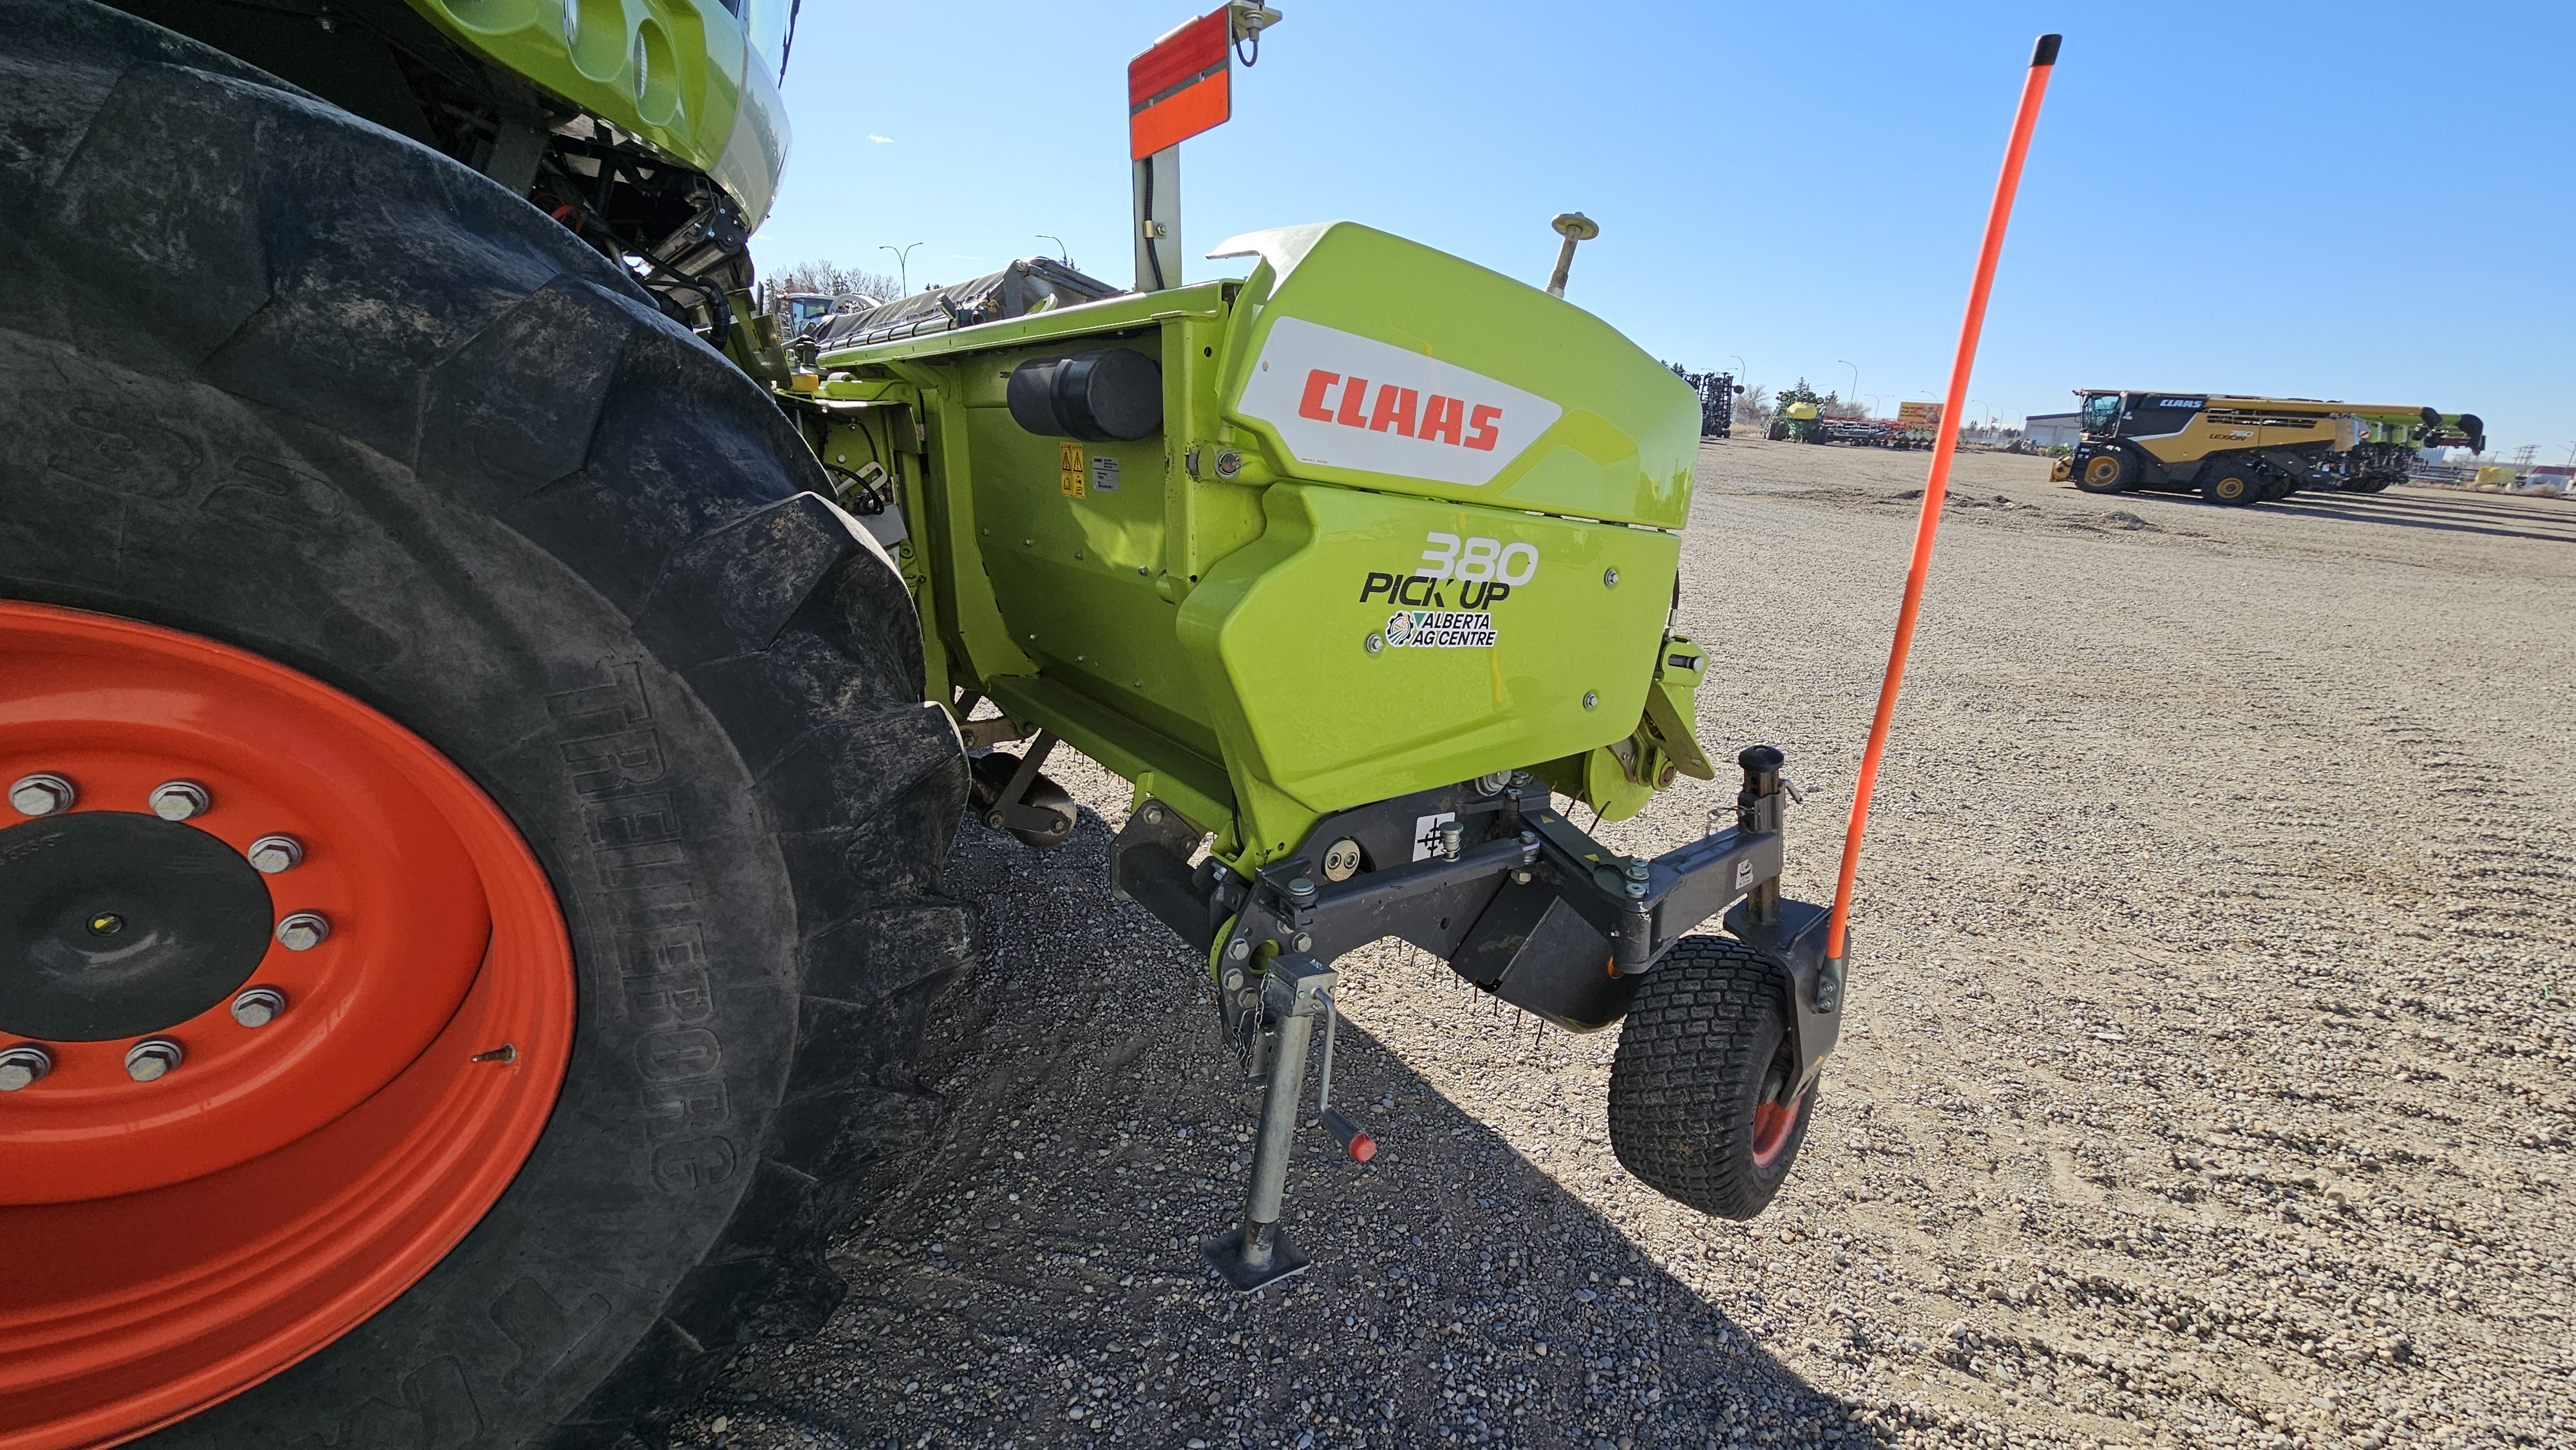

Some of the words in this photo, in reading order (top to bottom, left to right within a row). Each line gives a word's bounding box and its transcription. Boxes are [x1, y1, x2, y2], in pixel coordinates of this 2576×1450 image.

[1298, 369, 1502, 451] CLAAS
[2159, 399, 2202, 408] CLAAS
[1415, 532, 1539, 585] 380
[1359, 572, 1454, 608] PICK
[1459, 580, 1510, 610] UP
[1414, 631, 1435, 645] AG
[1437, 631, 1496, 646] CENTRE
[1421, 614, 1490, 630] ALBERTA
[544, 658, 736, 1194] TRELLEBORG
